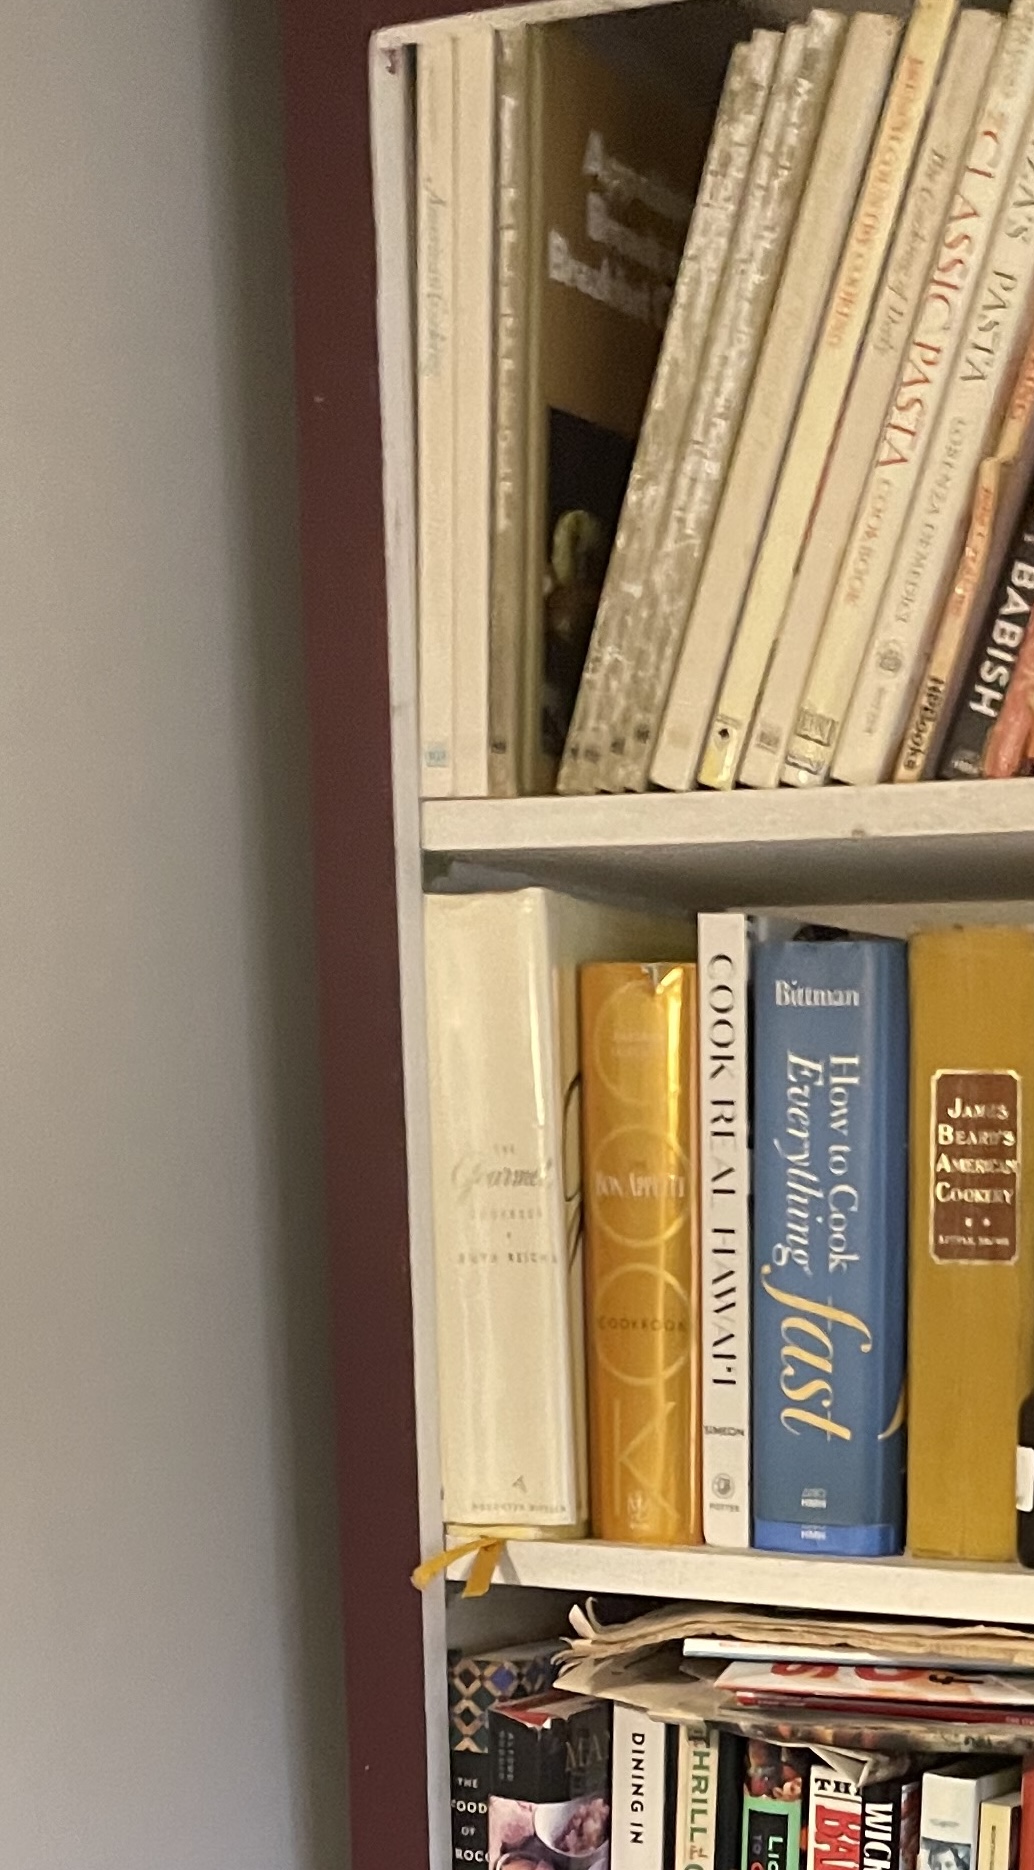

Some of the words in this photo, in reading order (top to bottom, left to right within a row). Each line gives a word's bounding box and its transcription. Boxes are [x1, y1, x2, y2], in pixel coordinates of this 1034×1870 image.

[916, 129, 999, 332] CLASSIC
[960, 270, 1017, 382] PASTA
[877, 340, 943, 467] PASTA
[708, 954, 736, 1080] COOK
[775, 979, 860, 1007] Bittman
[828, 1054, 860, 1136] How
[710, 1100, 736, 1208] REAL
[772, 1049, 825, 1277] Everything
[828, 1145, 851, 1176] to
[828, 1184, 860, 1275] Cook
[761, 1264, 873, 1441] fast
[458, 1778, 478, 1788] THE
[630, 1732, 646, 1812] DINING
[688, 1727, 711, 1843] THRILL
[629, 1823, 644, 1845] IN
[753, 1834, 763, 1855] TO
